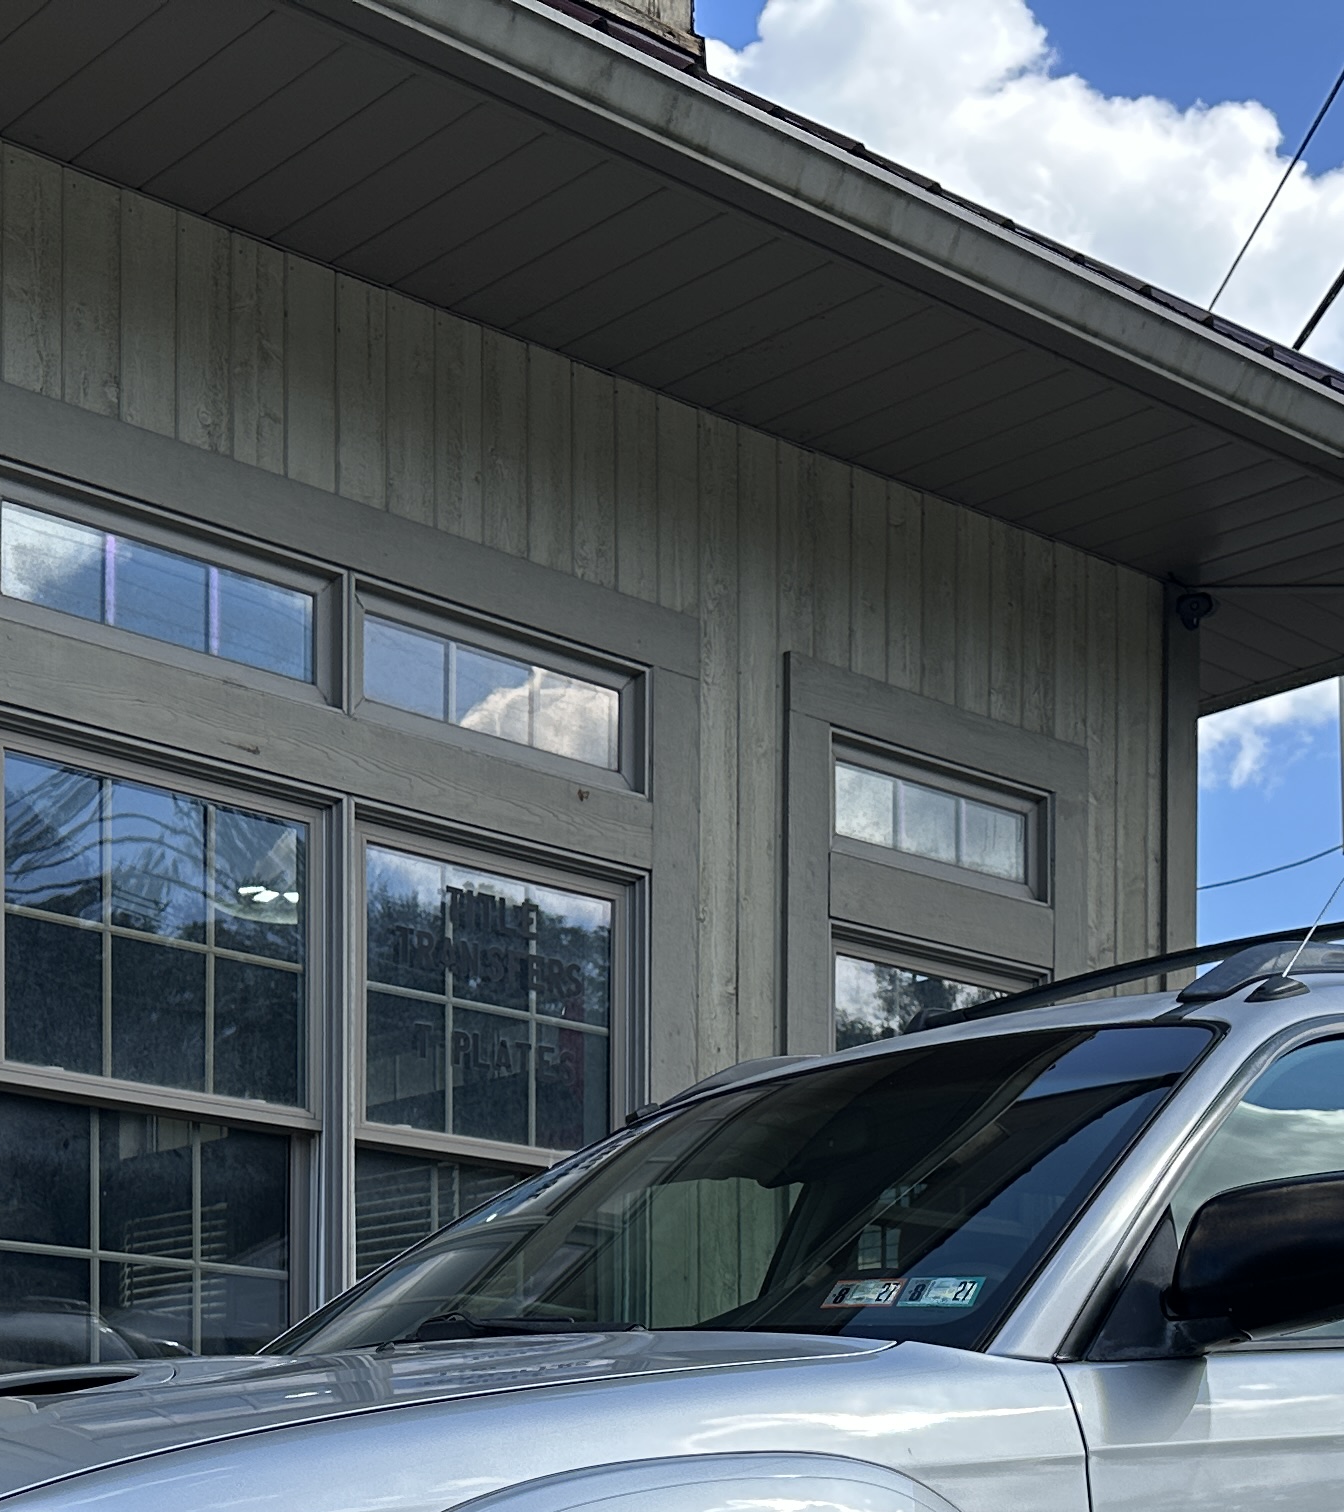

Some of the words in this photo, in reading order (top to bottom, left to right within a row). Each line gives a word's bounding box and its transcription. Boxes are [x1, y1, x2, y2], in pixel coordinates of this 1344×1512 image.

[445, 885, 539, 941] TITLE
[393, 925, 584, 997] TRANSFERS
[875, 1282, 901, 1304] 27
[952, 1280, 977, 1302] 27
